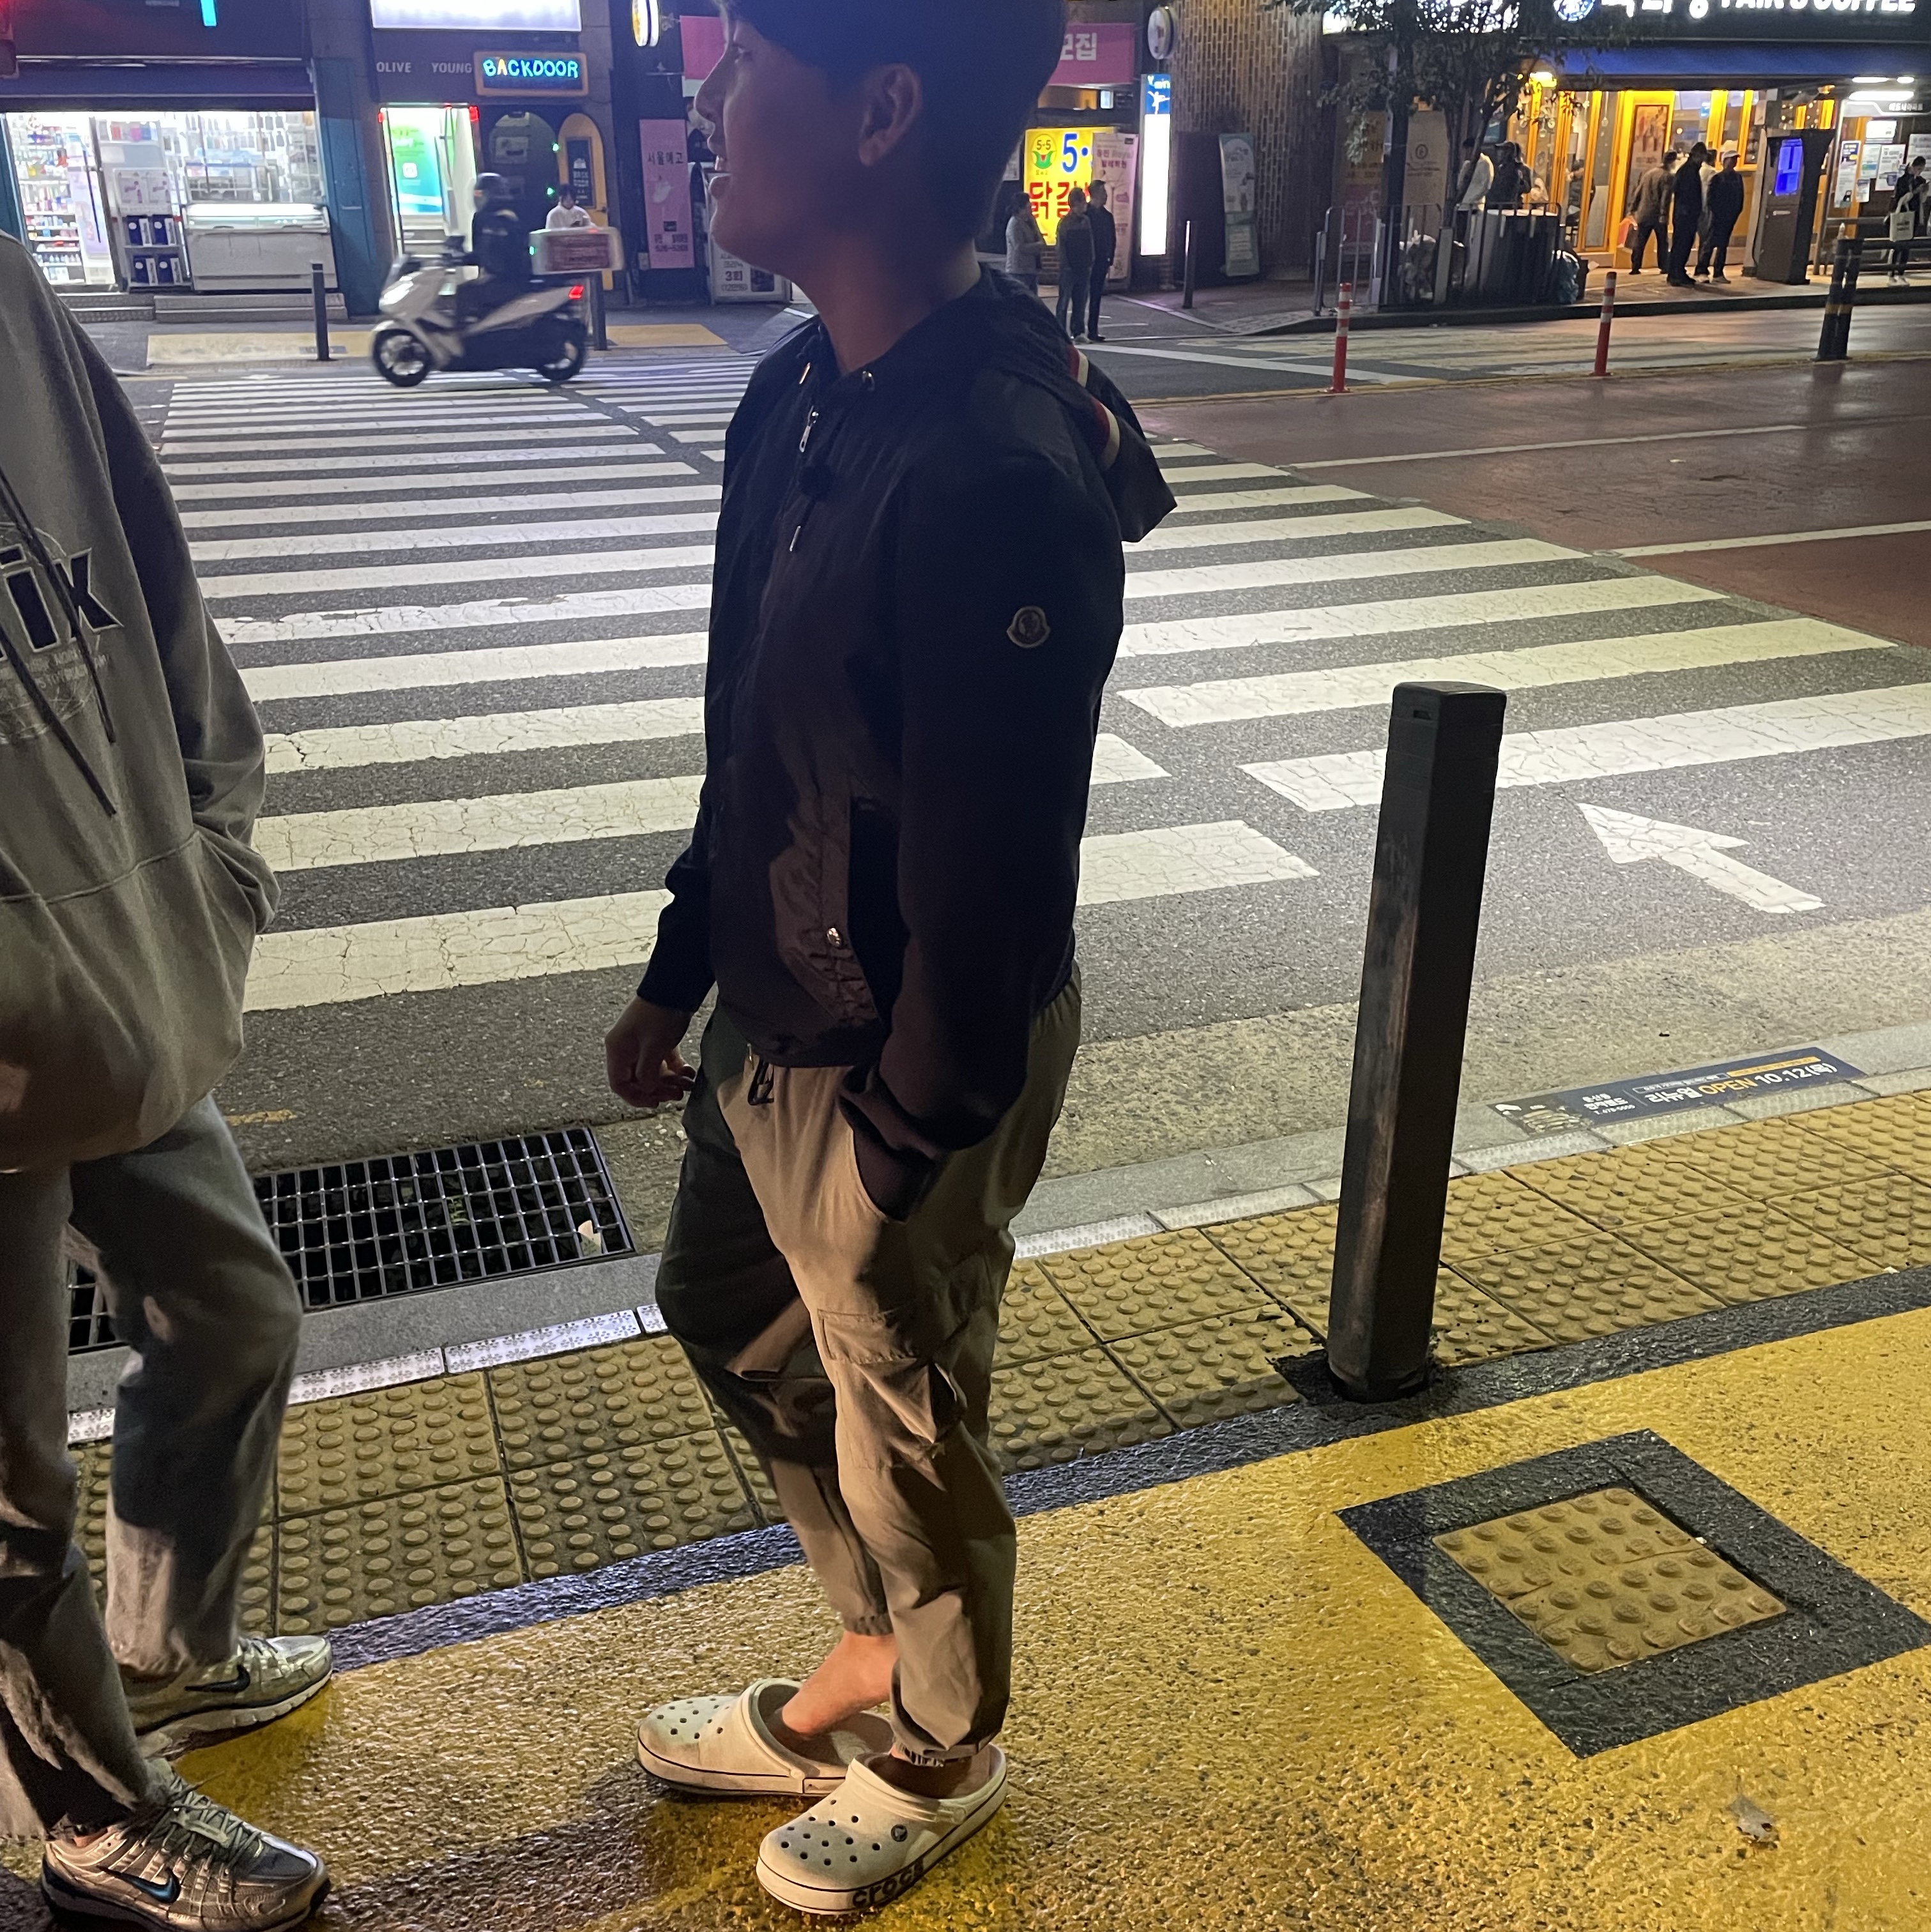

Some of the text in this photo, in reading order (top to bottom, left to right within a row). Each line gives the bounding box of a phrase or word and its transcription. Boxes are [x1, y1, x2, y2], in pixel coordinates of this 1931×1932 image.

[376, 61, 473, 73] OLIVE YOUNG
[483, 58, 579, 79] BACKDOOR
[1645, 1087, 1703, 1102] 리뉴얼
[1698, 1077, 1759, 1095] OPEN
